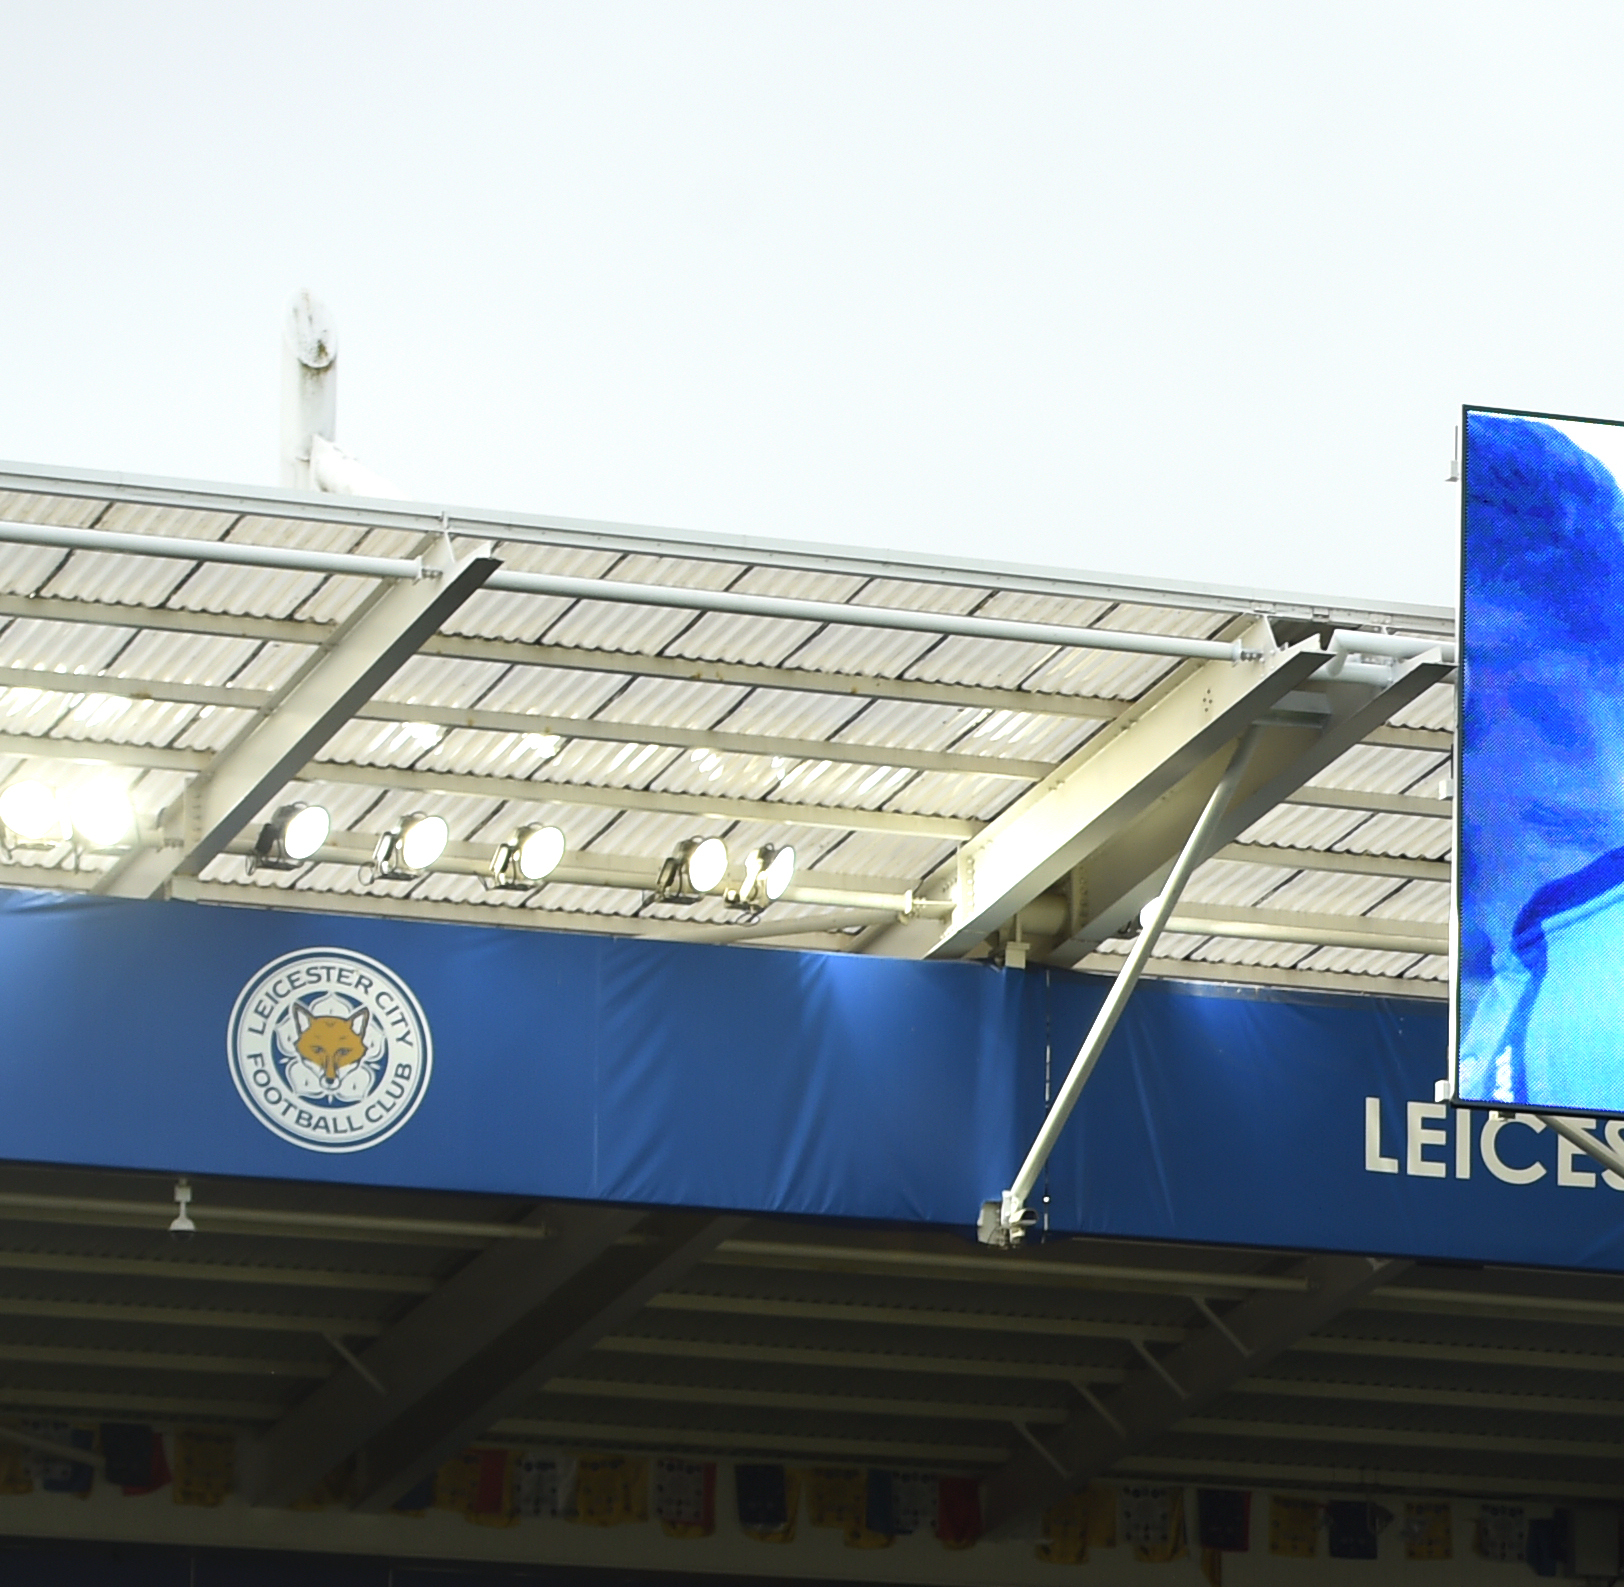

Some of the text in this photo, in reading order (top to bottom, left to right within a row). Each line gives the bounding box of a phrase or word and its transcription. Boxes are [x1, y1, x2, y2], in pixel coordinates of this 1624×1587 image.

[249, 966, 414, 1048] LEICESTER CITY
[247, 1053, 413, 1135] FOOTBALL CLUB
